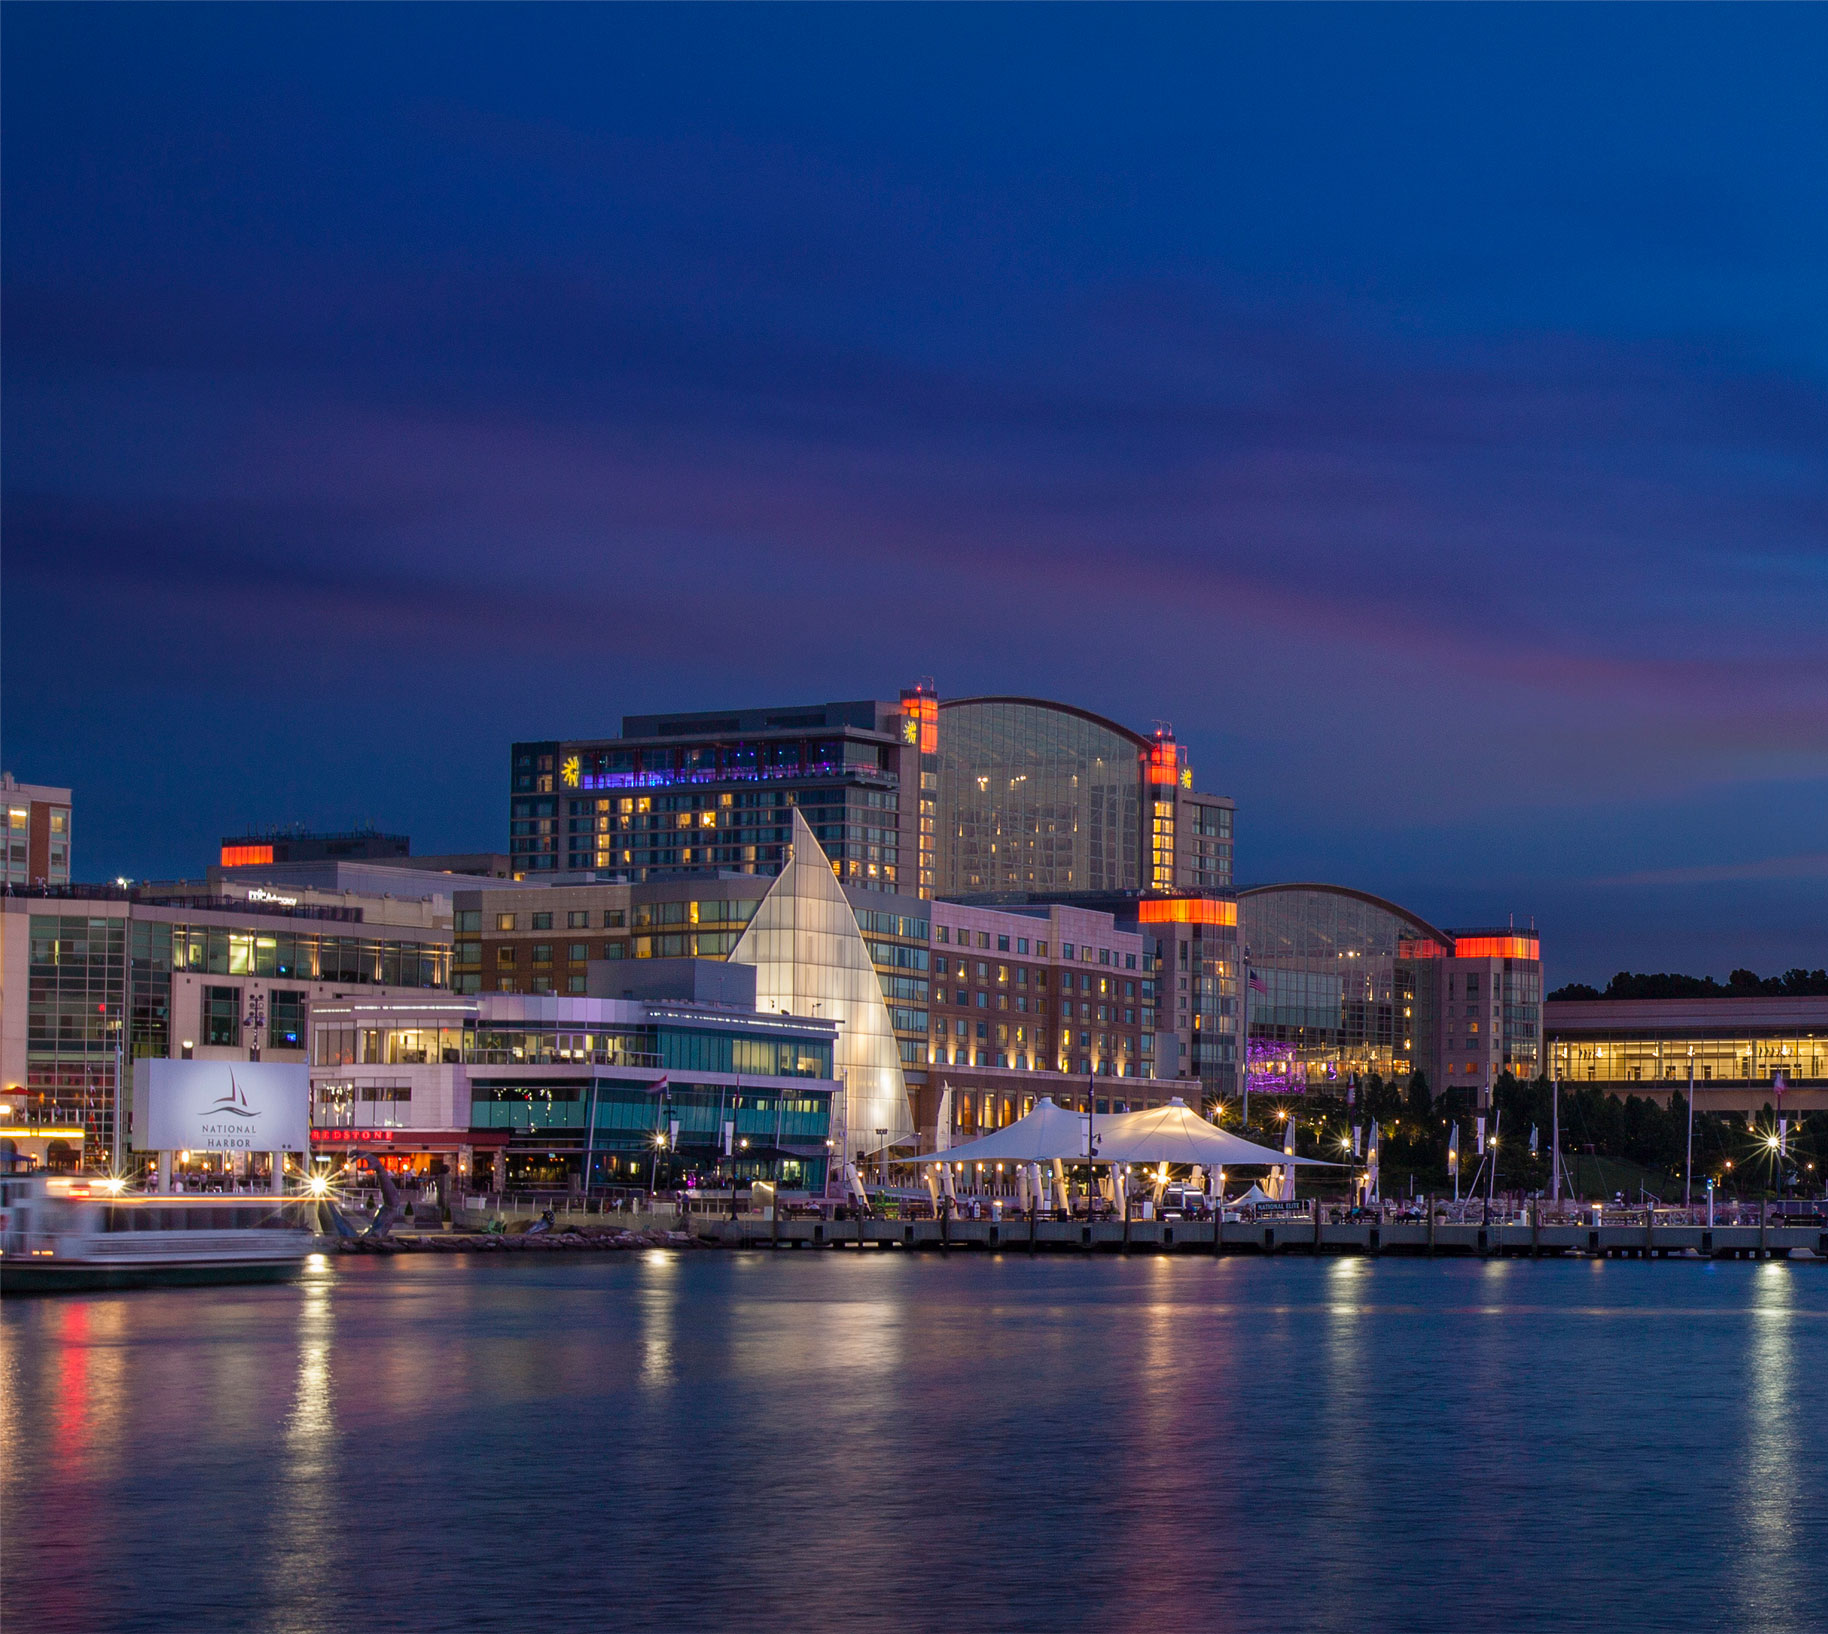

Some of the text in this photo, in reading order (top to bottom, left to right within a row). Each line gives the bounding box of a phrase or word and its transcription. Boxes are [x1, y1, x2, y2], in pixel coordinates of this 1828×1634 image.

[202, 1125, 257, 1134] NATIONAL
[311, 1129, 393, 1141] REDSTONE
[207, 1138, 251, 1148] HARBOR
